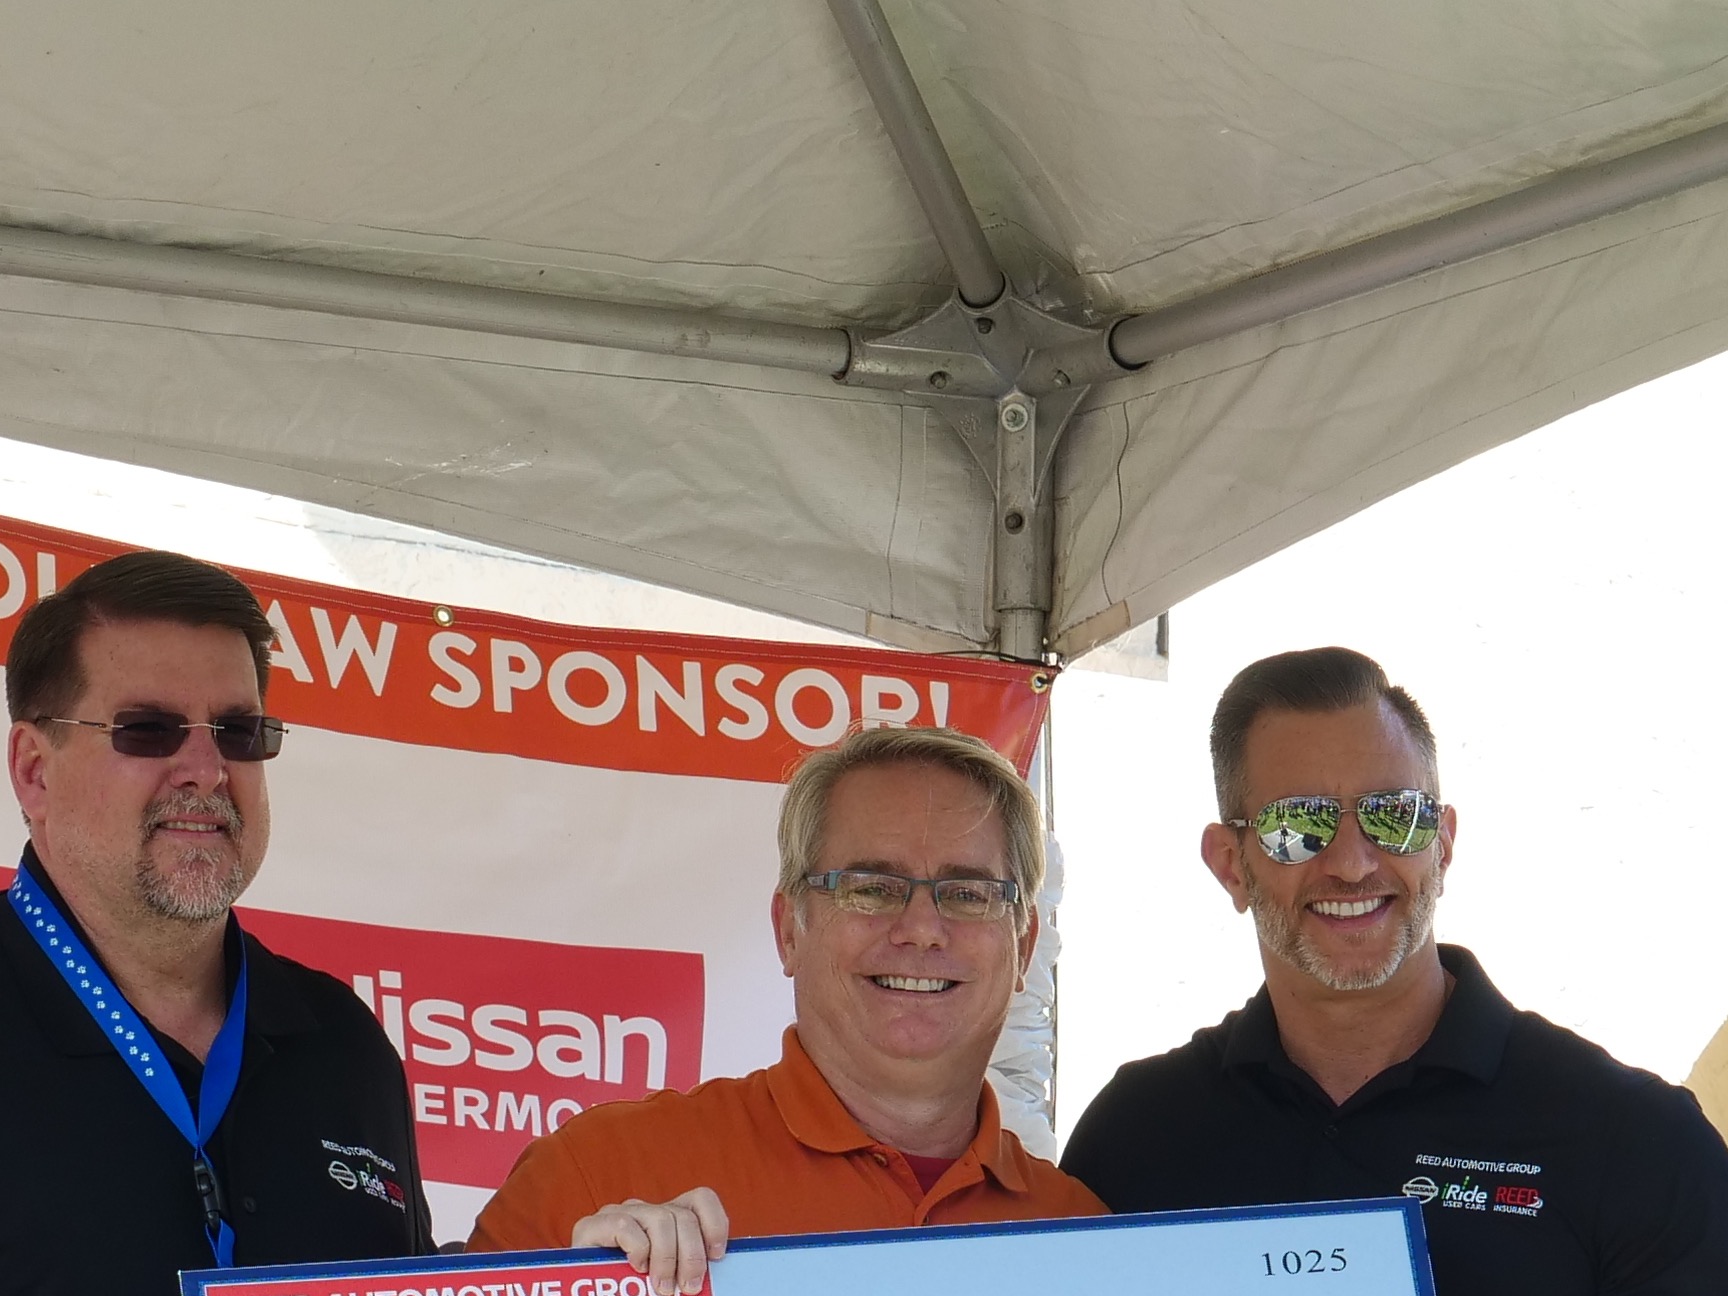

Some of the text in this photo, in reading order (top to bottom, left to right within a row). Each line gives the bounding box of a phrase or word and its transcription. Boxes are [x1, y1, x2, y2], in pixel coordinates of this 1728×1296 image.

[269, 599, 398, 698] AW
[428, 631, 950, 747] SPONSOR!
[413, 1083, 584, 1138] ERMO
[1416, 1154, 1542, 1175] REED AUTOMOTIVE GROUP
[1493, 1204, 1538, 1218] INSURANCE
[1260, 1246, 1349, 1278] 1025
